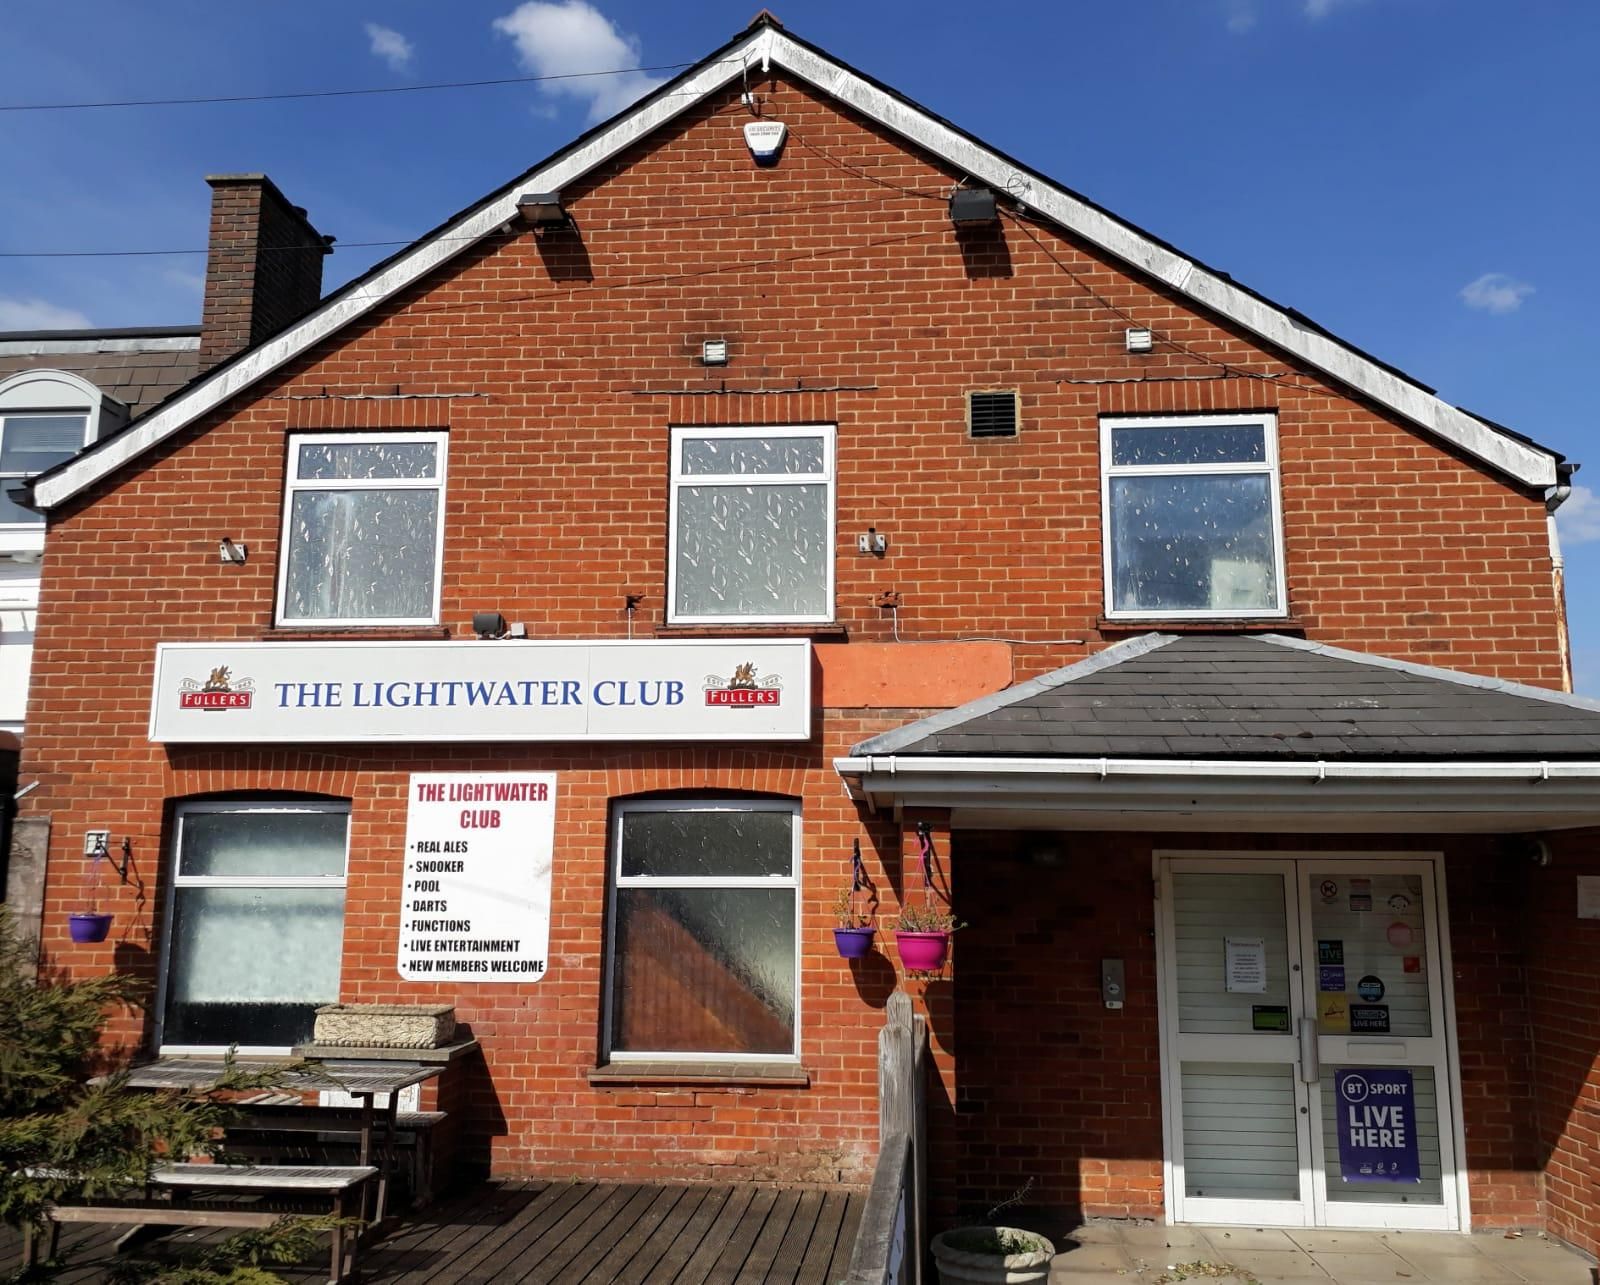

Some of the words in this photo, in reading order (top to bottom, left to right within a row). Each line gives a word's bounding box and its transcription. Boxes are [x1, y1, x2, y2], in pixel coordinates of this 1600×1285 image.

[274, 683, 342, 707] THE
[353, 680, 582, 707] LIGHTWATER
[593, 680, 684, 706] CLUB
[417, 783, 445, 802] THE
[449, 783, 548, 802] LIGHTWATER
[460, 810, 501, 828] CLUB
[417, 841, 442, 853] REAL
[444, 841, 468, 853] ALES
[416, 861, 464, 873] SNOOKER
[414, 880, 440, 892] POOL
[412, 900, 447, 912] DARTS
[411, 920, 471, 932] FUNCTIONS
[410, 940, 432, 952] LIVE
[434, 940, 520, 952] ENTERTAINMENT
[1320, 949, 1342, 959] LIVE
[409, 960, 434, 972] NEW
[436, 960, 488, 972] MEMBERS
[490, 961, 544, 972] WELCOME
[1353, 1020, 1369, 1028] LIVE
[1370, 1020, 1387, 1028] HERE
[1347, 1083, 1362, 1094] BT
[1370, 1083, 1407, 1095] SPORT
[1349, 1105, 1404, 1128] LIVE
[1350, 1128, 1406, 1148] HERE
